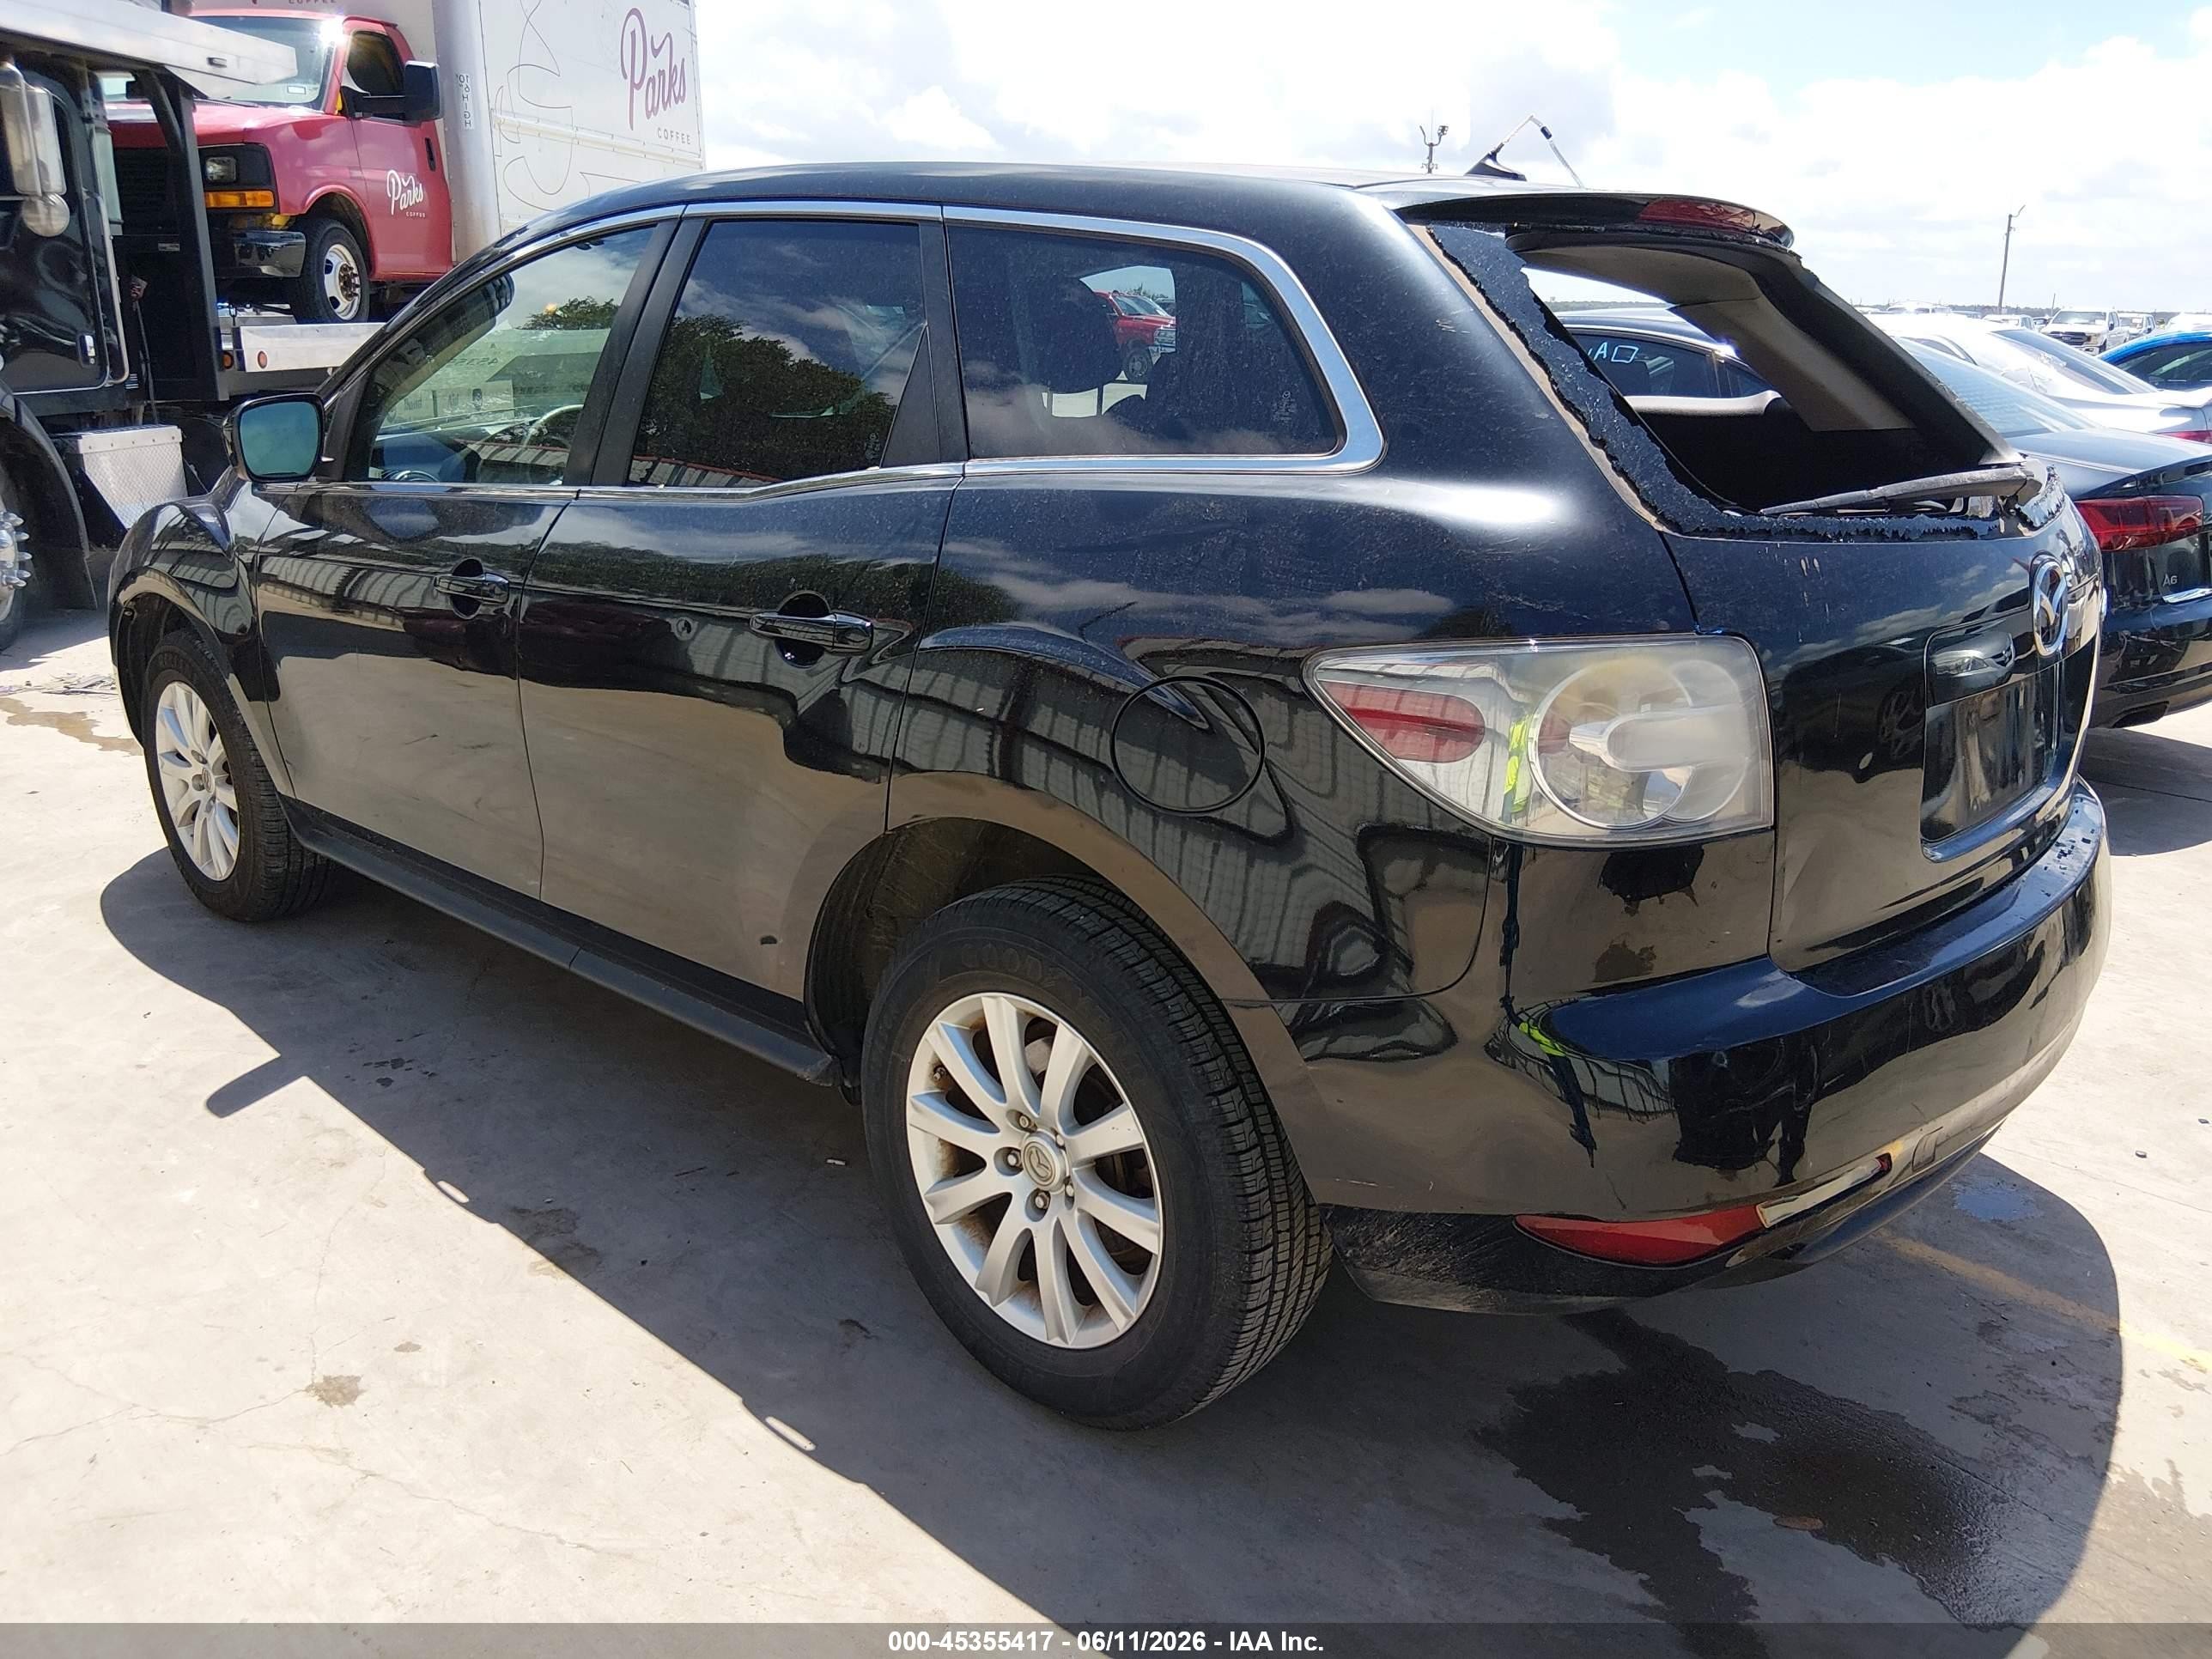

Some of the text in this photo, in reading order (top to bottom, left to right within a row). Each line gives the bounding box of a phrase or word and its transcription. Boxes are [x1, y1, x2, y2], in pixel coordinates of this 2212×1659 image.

[621, 8, 686, 131] Parks
[658, 127, 690, 144] COFFEE
[386, 169, 423, 216] Parks
[2162, 573, 2178, 587] A6
